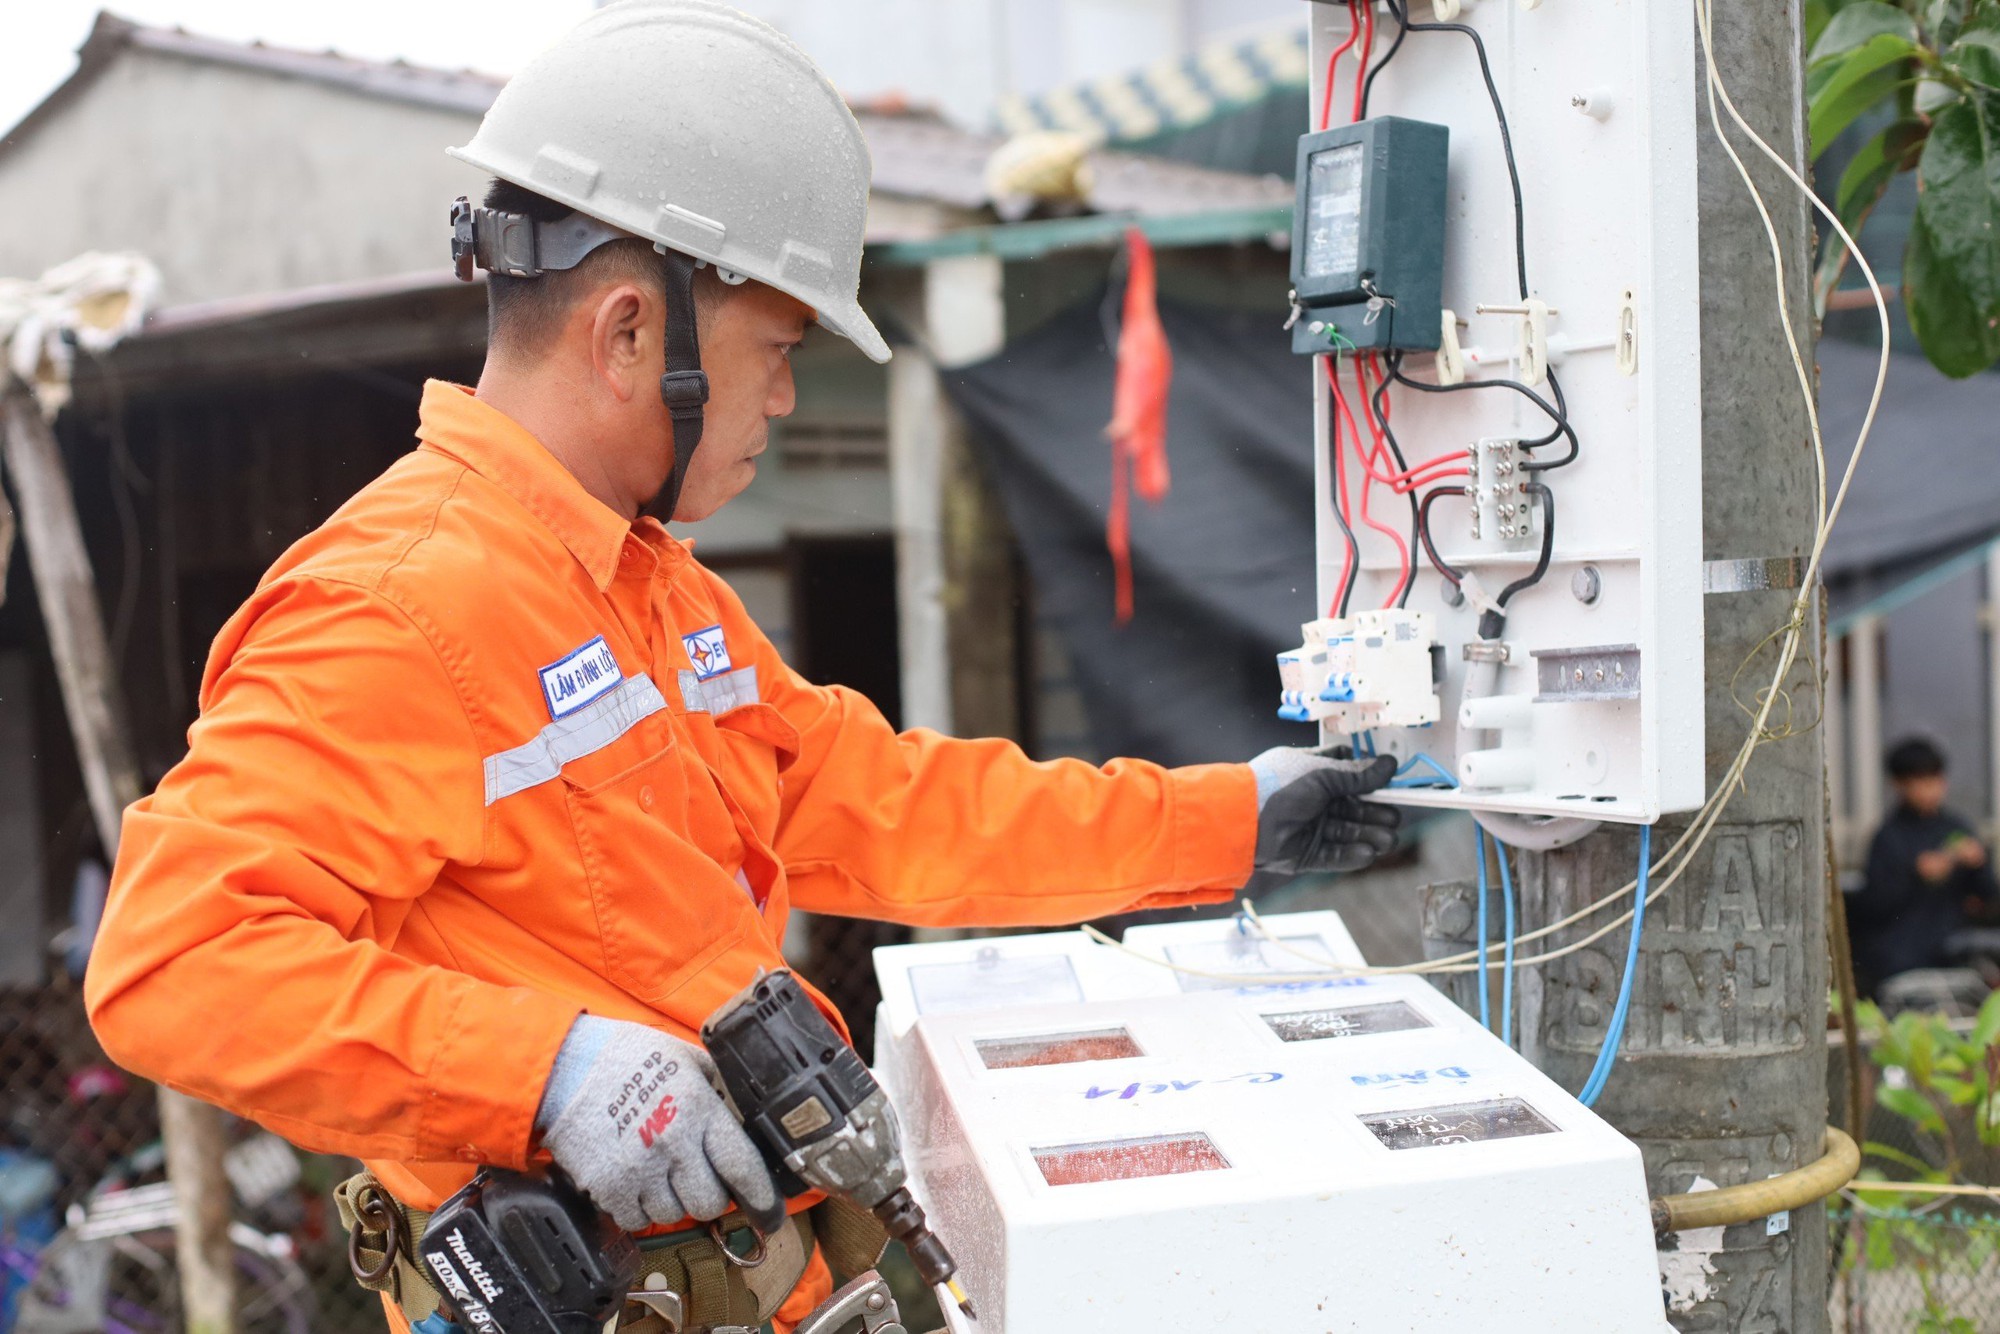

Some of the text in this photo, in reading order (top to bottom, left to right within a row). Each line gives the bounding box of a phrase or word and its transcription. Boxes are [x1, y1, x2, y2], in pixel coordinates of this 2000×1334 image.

[551, 673, 577, 702] LÂM
[607, 1072, 643, 1118] dụng
[617, 1060, 679, 1137] Găng tay
[638, 1095, 677, 1149] 3M
